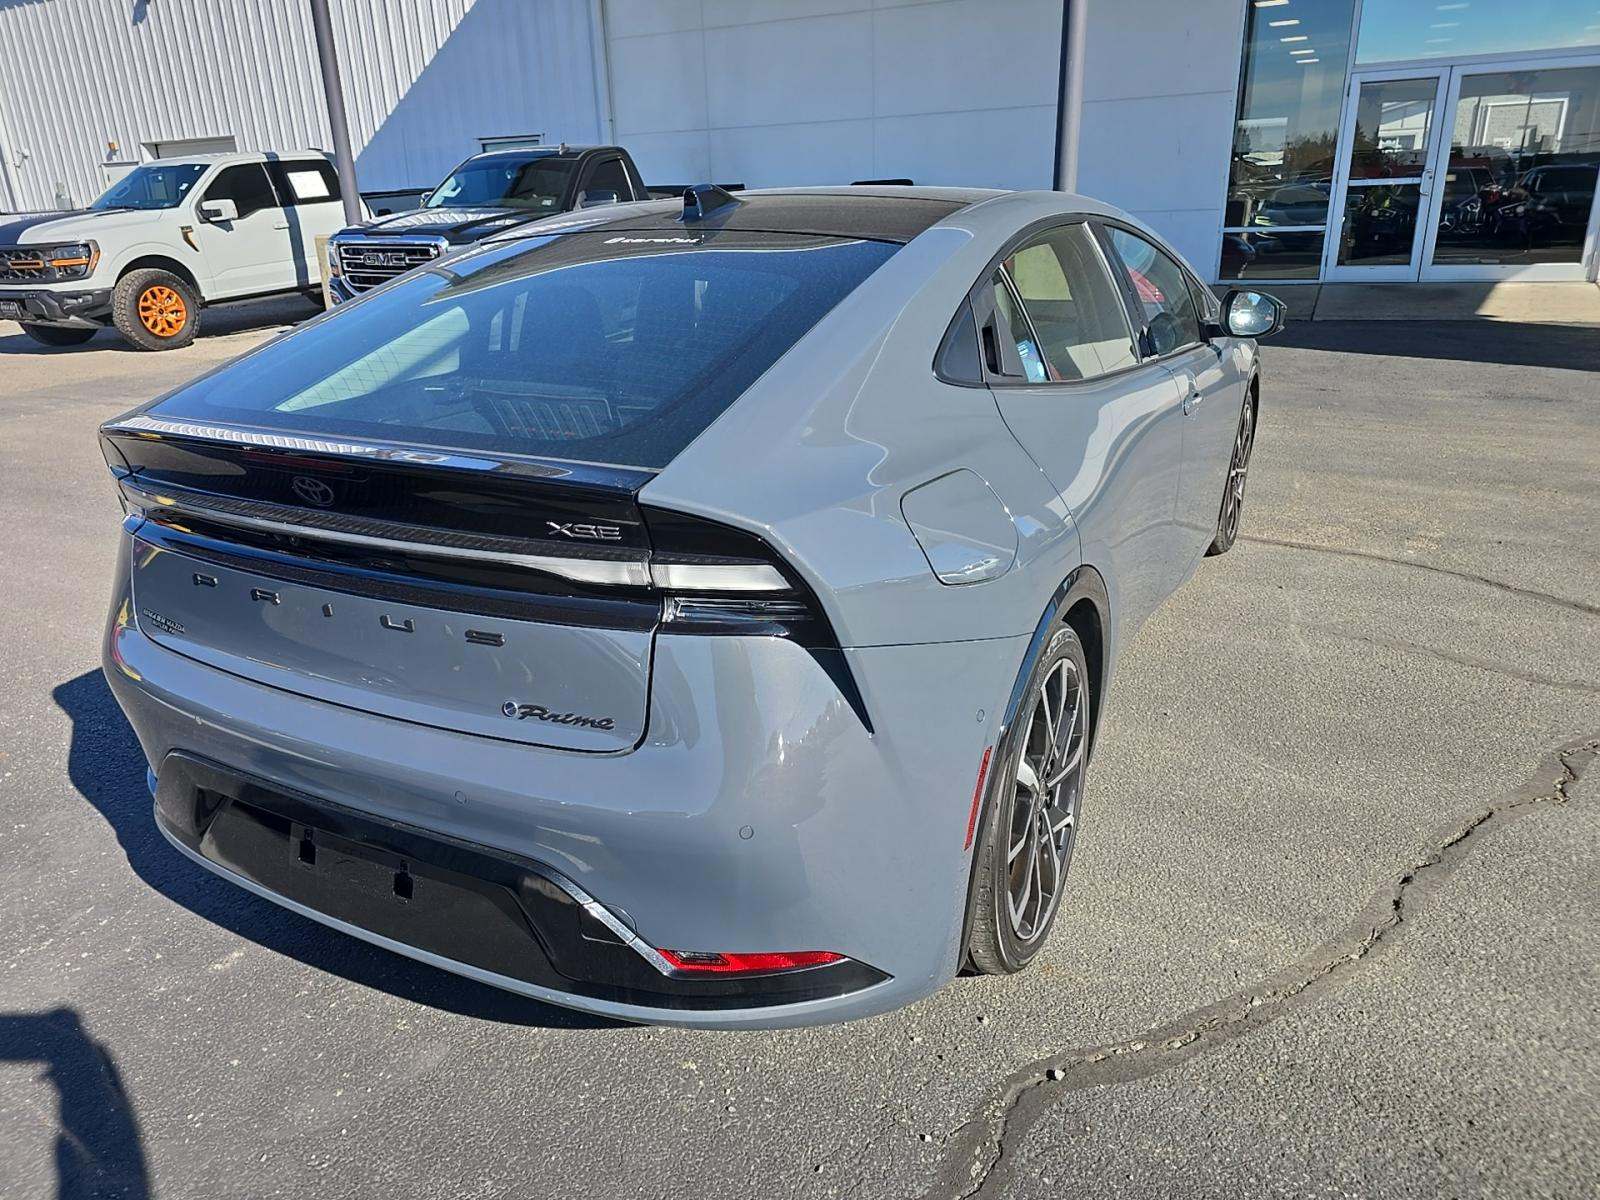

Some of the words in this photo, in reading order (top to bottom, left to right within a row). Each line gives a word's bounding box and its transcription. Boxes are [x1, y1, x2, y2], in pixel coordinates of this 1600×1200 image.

[362, 252, 407, 267] GMC
[546, 520, 623, 541] XSE
[194, 573, 506, 647] PRIUS
[518, 704, 615, 730] Prime
